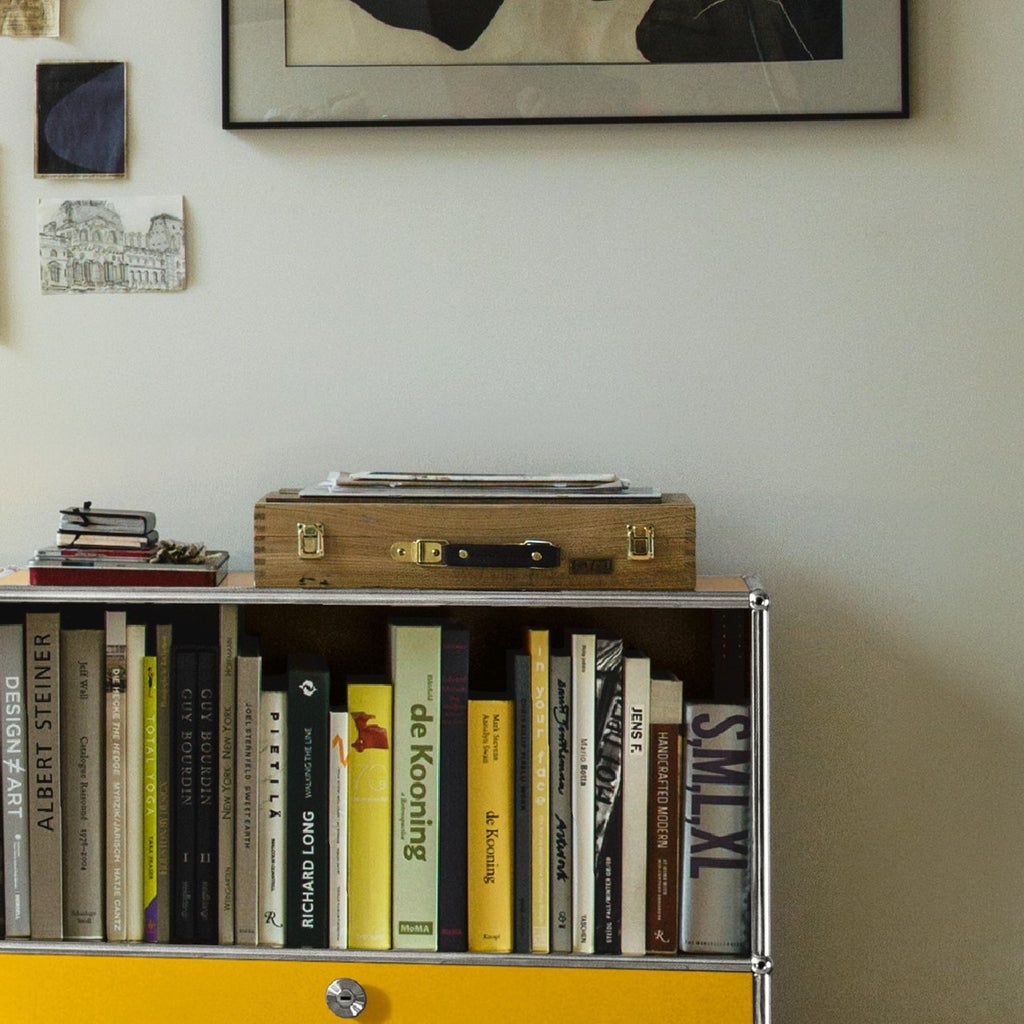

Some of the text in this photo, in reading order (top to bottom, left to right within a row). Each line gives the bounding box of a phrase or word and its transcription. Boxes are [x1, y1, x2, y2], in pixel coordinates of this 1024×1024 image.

[78, 661, 89, 677] Jeff
[112, 668, 121, 684] DIE
[78, 679, 89, 700] Wall
[112, 686, 121, 720] HECKE
[180, 688, 192, 722] GUY
[200, 688, 212, 722] GUY
[34, 633, 54, 832] ALBERT STEINER
[112, 722, 121, 740] THE
[146, 716, 155, 763] TOTAL
[304, 728, 313, 745] LINE
[492, 714, 500, 733] Mark
[630, 707, 643, 753] JENS F.
[5, 676, 23, 818] DESIGN ART
[78, 736, 89, 778] Catalogue
[112, 743, 121, 775] HEDGE
[304, 745, 313, 761] THE
[180, 731, 192, 806] BOURDIN
[200, 731, 212, 806] BOURDIN
[244, 703, 252, 849] JOEL STERNFELD SWEET EARTH
[403, 704, 433, 862] de Kooning
[78, 781, 89, 820] Raisonné
[146, 774, 155, 816] YOGA
[657, 732, 669, 849] HANDCRAFTED MODERN
[483, 811, 499, 885] de Kooning
[580, 738, 588, 943] Mario Botta TASCHEN
[112, 868, 121, 897] HATJE
[302, 811, 315, 929] RICHARD LONG
[112, 899, 121, 932] CANTZ
[400, 925, 430, 933] MoMA
